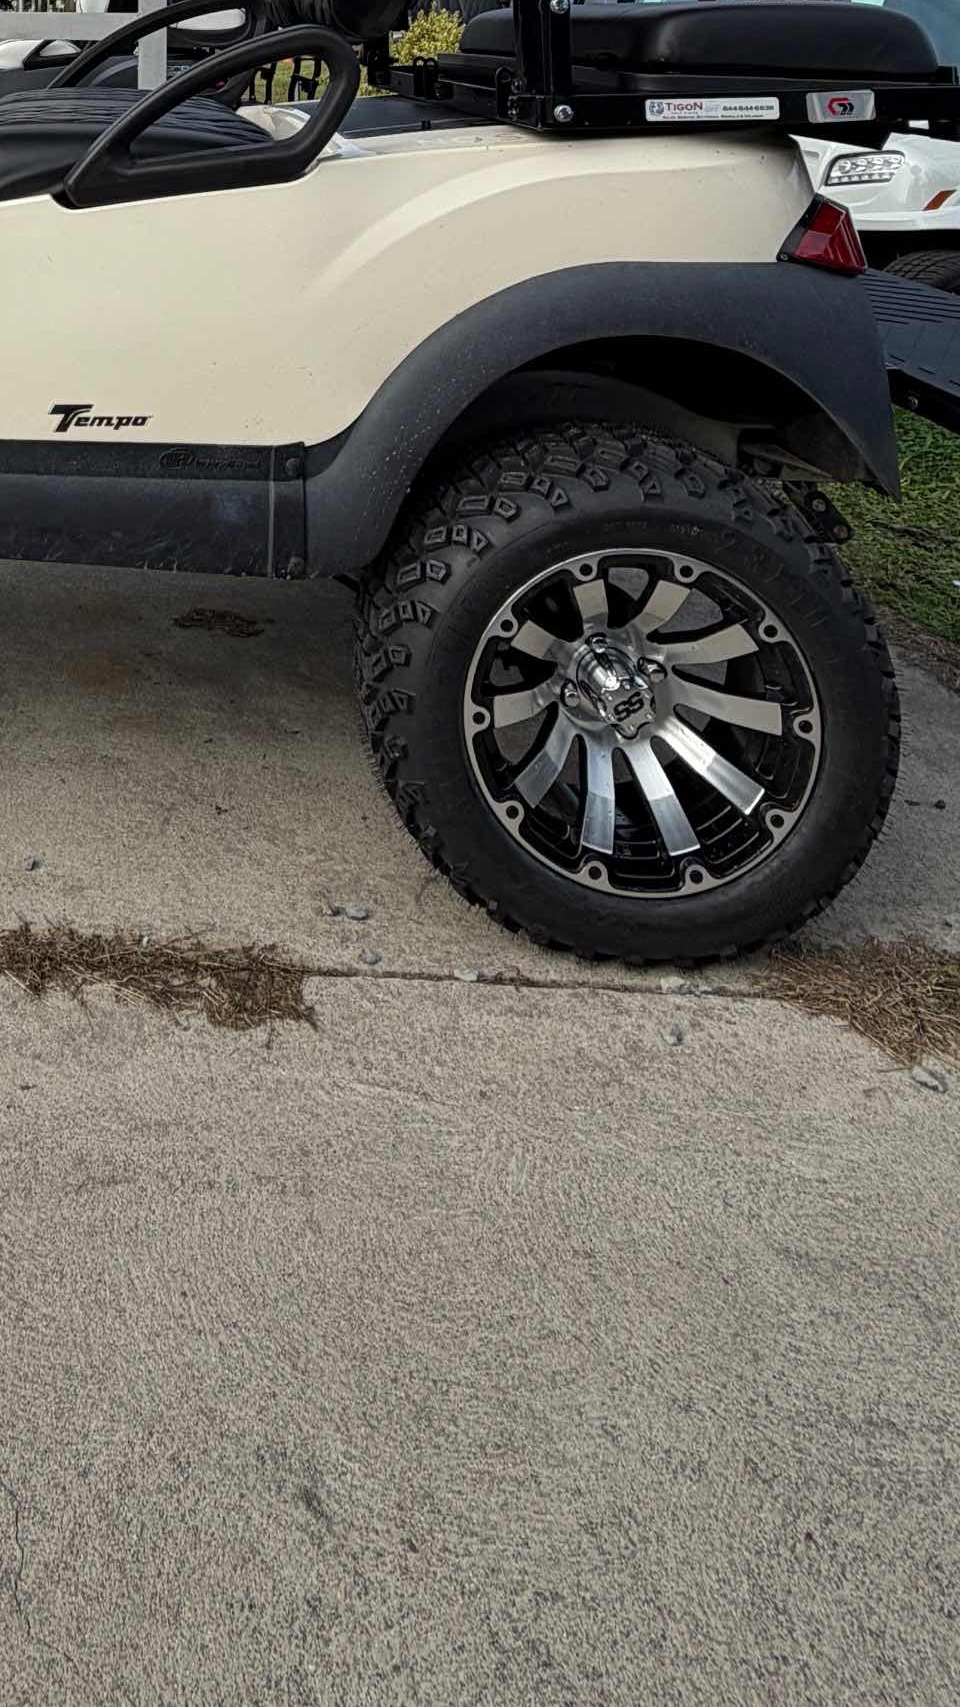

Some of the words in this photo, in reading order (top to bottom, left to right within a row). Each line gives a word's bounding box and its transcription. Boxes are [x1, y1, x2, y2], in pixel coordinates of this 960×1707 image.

[664, 101, 703, 112] TIGON
[49, 404, 150, 433] Tempo
[613, 691, 644, 722] SS
